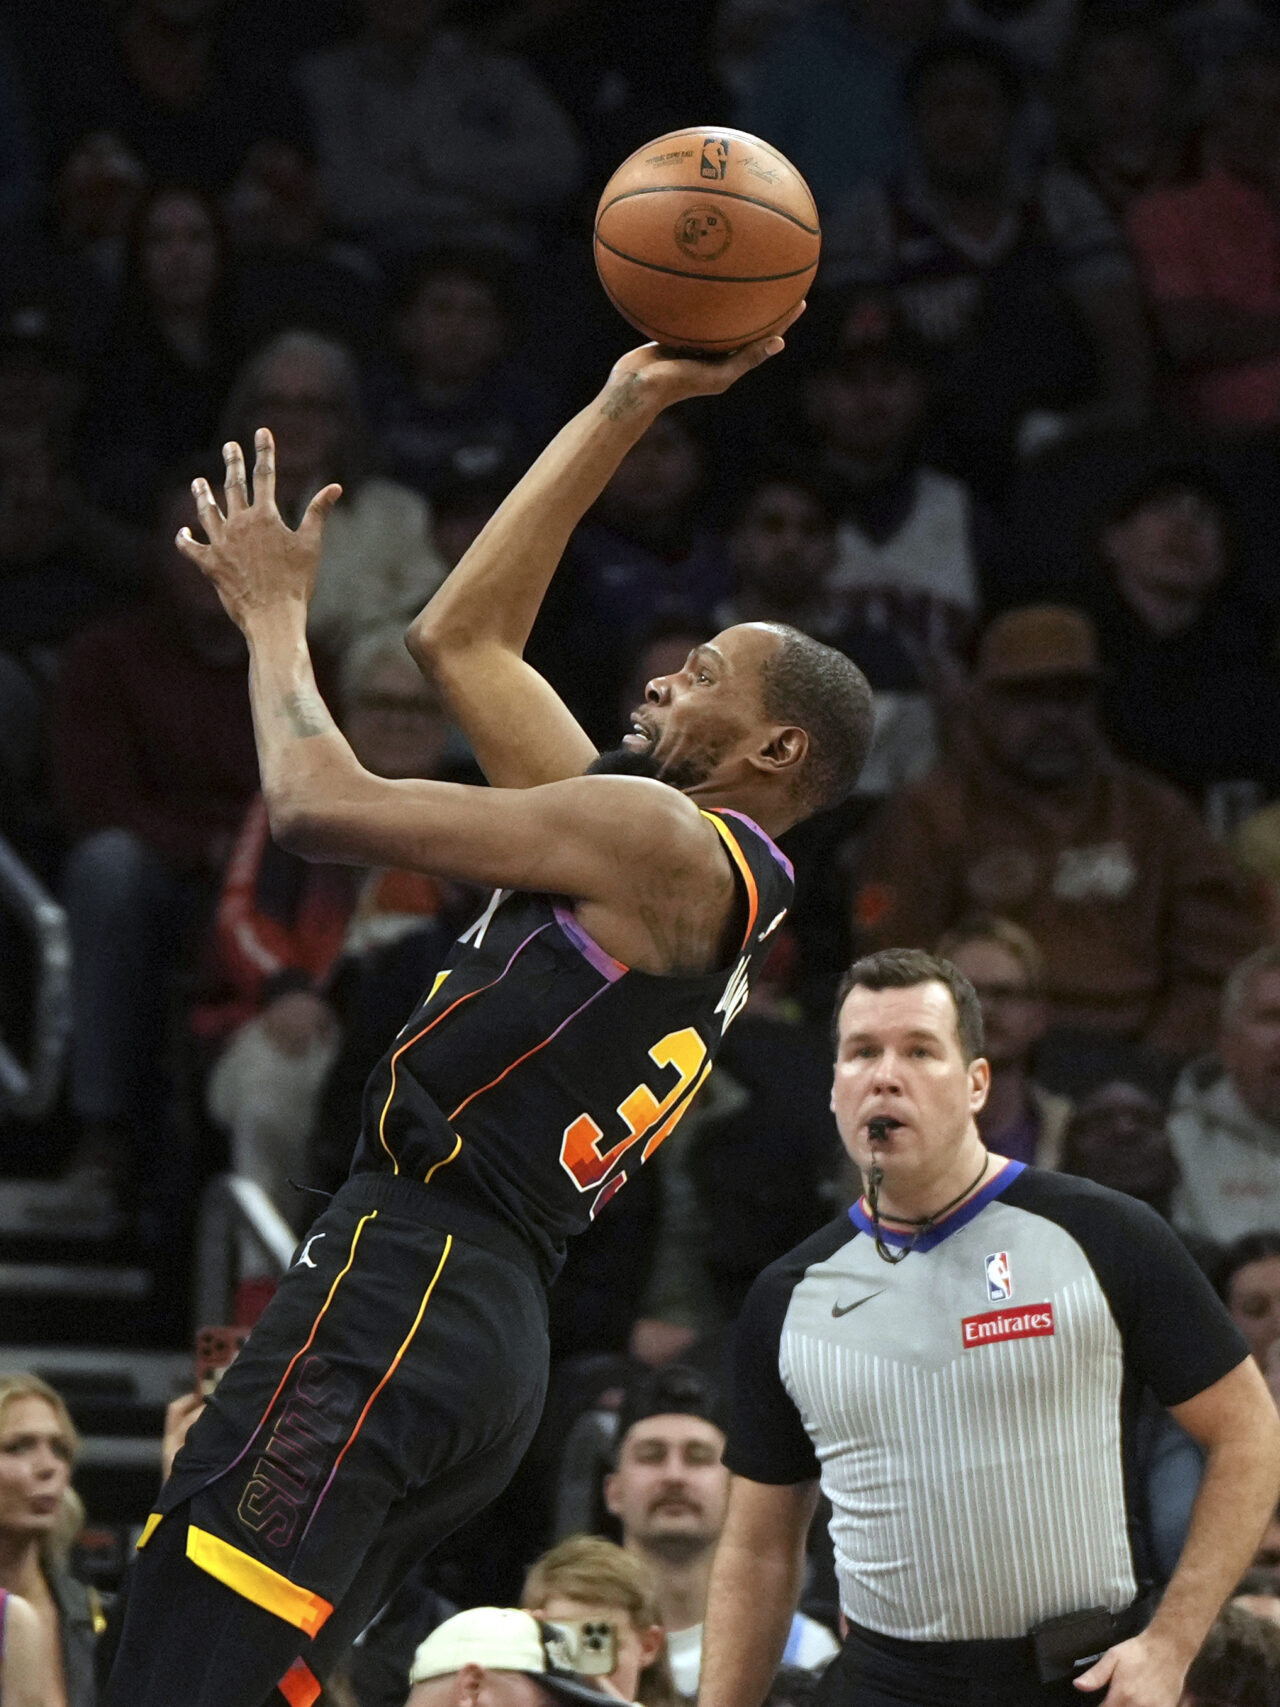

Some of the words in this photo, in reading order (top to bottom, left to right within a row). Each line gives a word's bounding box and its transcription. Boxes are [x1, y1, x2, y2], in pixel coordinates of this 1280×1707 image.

[559, 1026, 713, 1221] 3
[965, 1312, 1052, 1341] Emirates
[237, 1356, 358, 1548] SUNS
